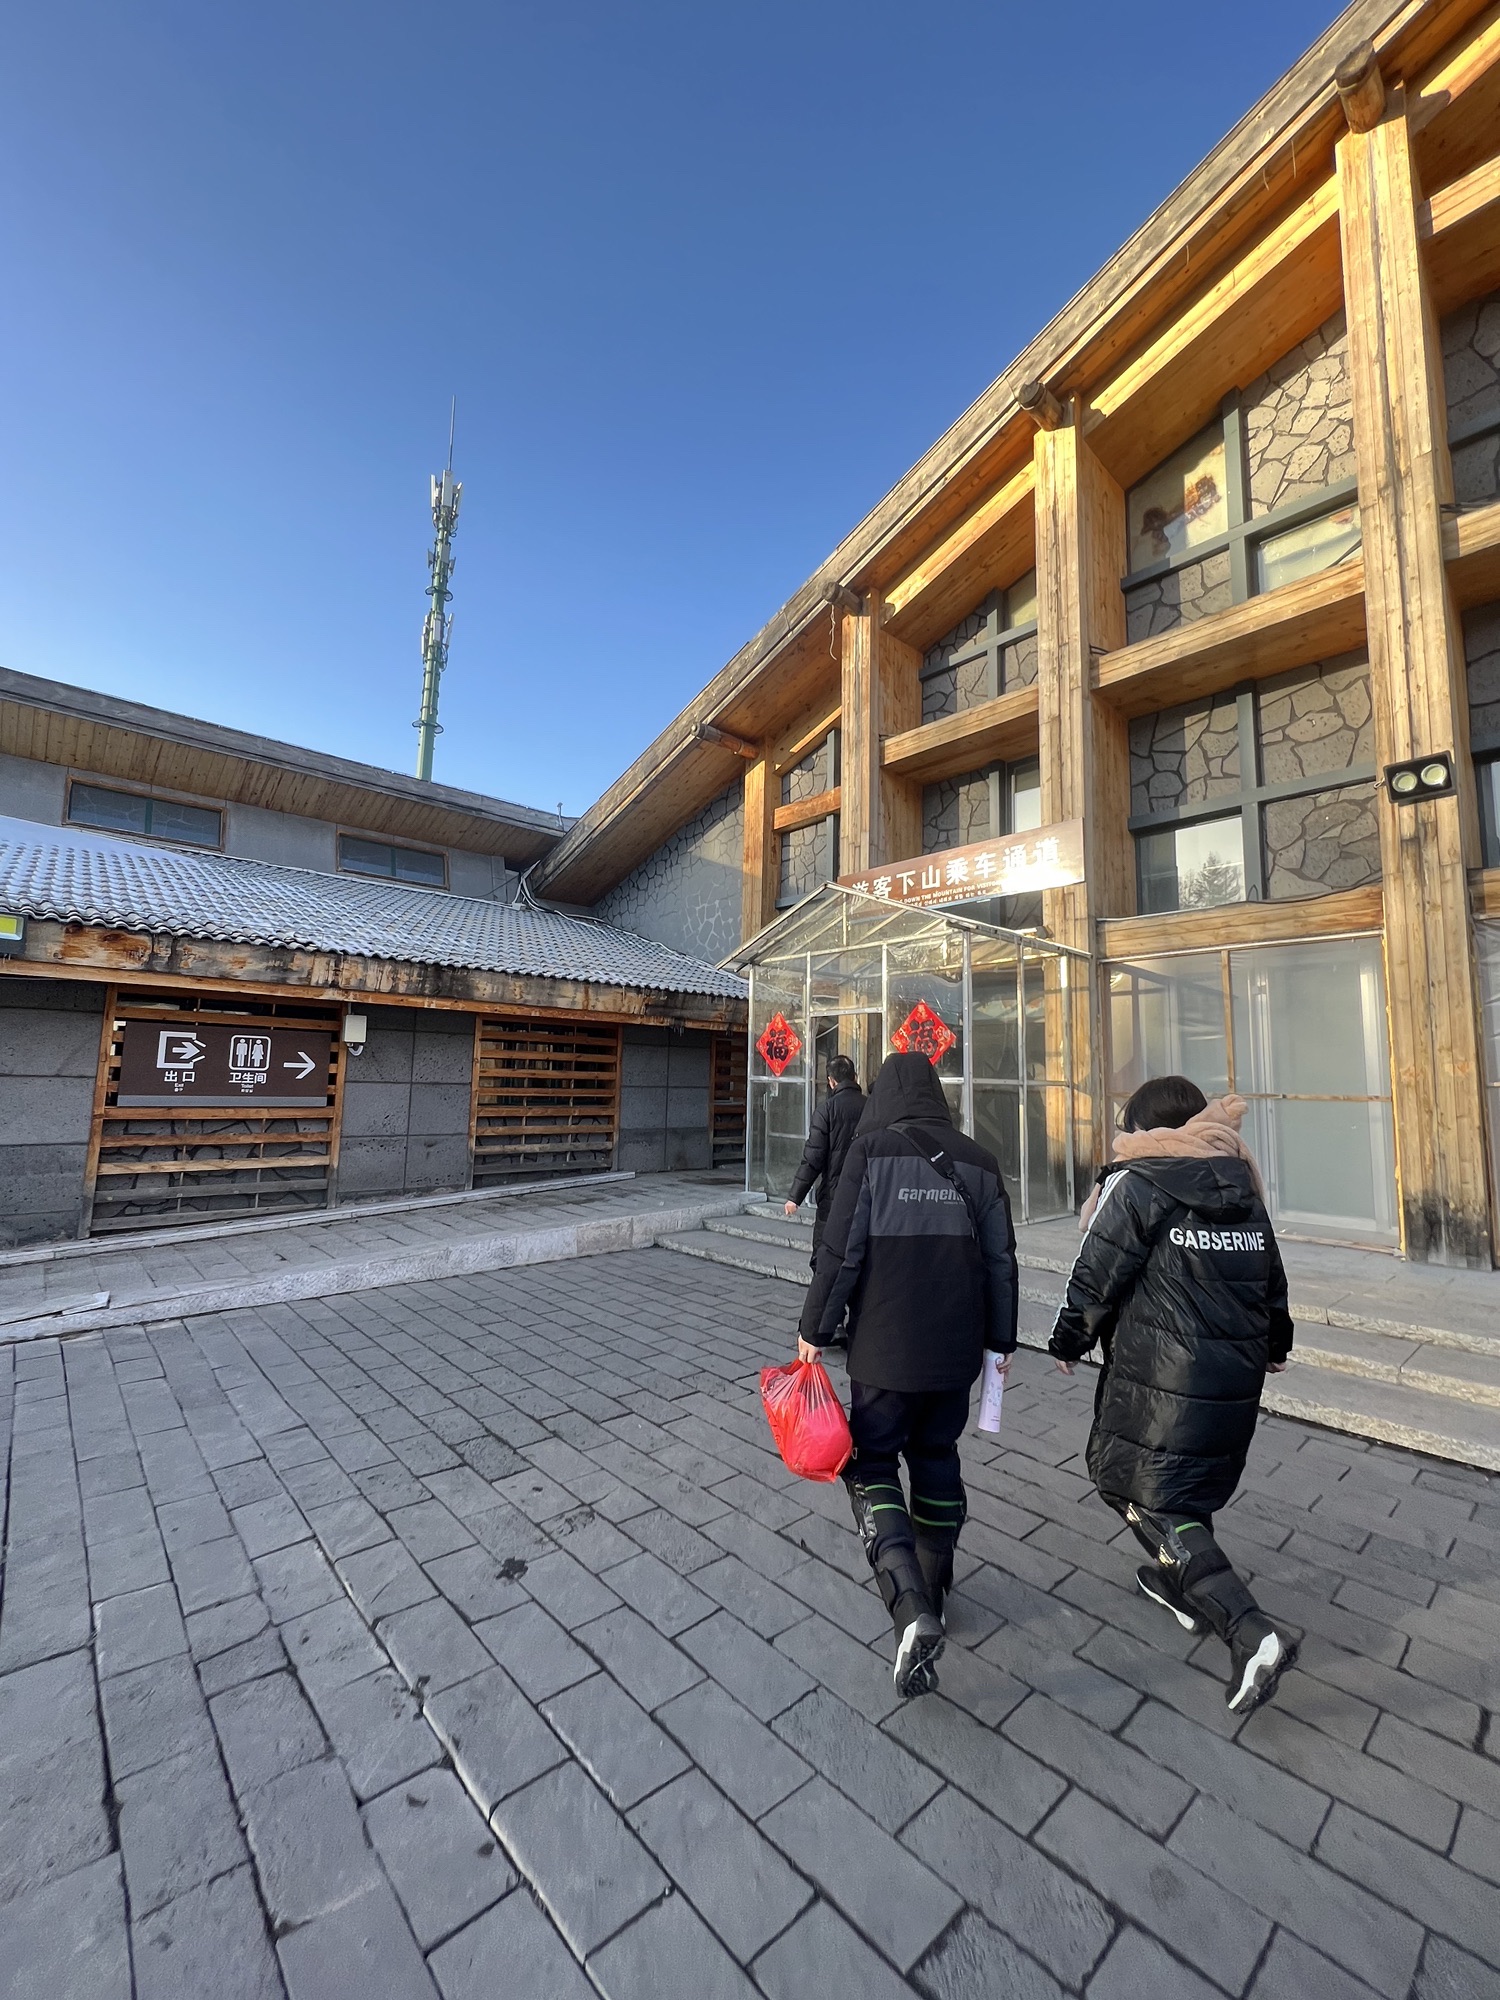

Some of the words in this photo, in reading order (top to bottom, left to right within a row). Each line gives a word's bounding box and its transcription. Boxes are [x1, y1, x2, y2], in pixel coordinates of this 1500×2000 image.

[933, 887, 963, 898] MOUNTAIN
[964, 884, 976, 892] FOR
[766, 1028, 789, 1061] 福
[164, 1070, 195, 1082] 出口
[228, 1072, 267, 1084] 卫生间
[1169, 1227, 1265, 1251] GABSERINE
